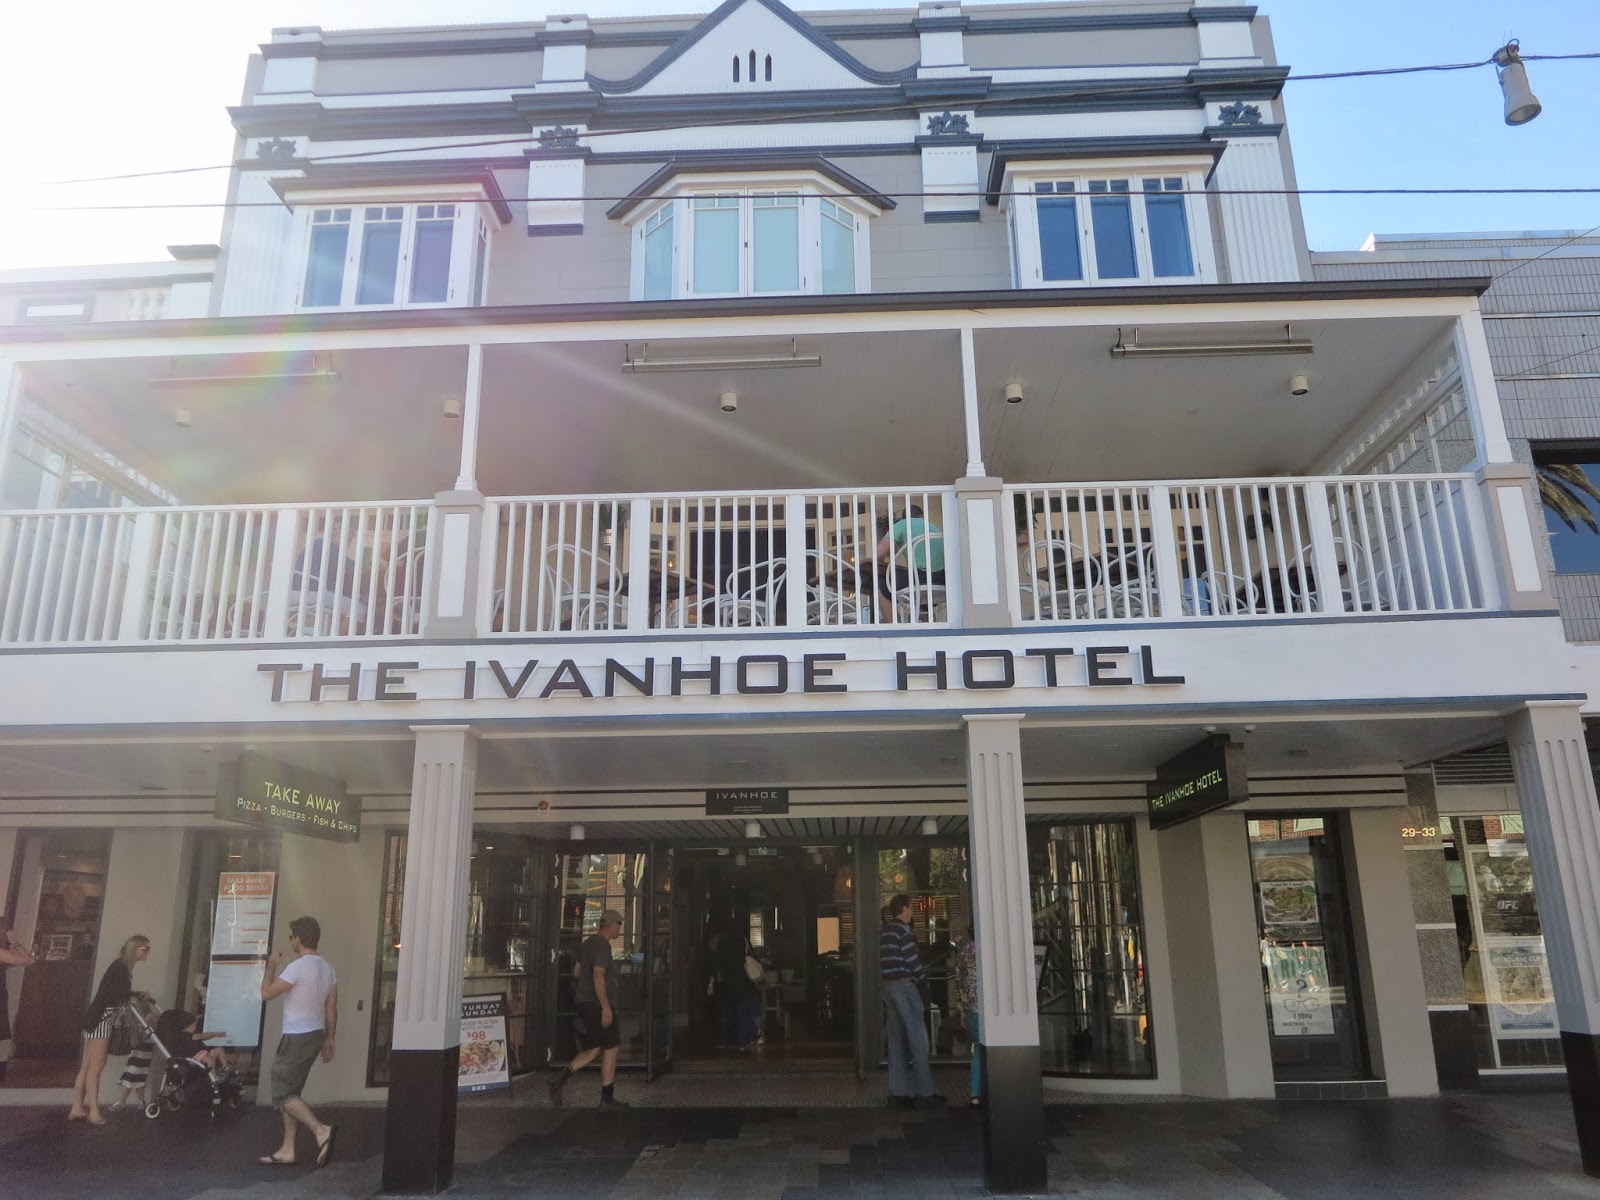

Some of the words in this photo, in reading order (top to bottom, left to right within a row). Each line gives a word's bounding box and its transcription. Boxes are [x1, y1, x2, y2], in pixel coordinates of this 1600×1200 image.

[257, 662, 419, 702] THE
[463, 653, 848, 700] IVANHOE
[896, 645, 1185, 691] HOTEL
[1152, 796, 1164, 810] THE
[1165, 782, 1194, 804] IVANHOE
[1196, 769, 1223, 791] HOTEL
[264, 781, 301, 805] TAKE
[305, 793, 341, 814] AWAY
[716, 791, 778, 800] IVANHOE
[236, 797, 262, 813] PIZZA
[270, 805, 306, 822] BURGERS
[313, 815, 329, 827] FISH
[330, 819, 337, 829] &
[338, 820, 358, 833] CHIPS
[1401, 827, 1436, 838] 29-33
[1496, 899, 1520, 910] UFC
[463, 1003, 501, 1011] TURDAY
[467, 1031, 486, 1040] $98
